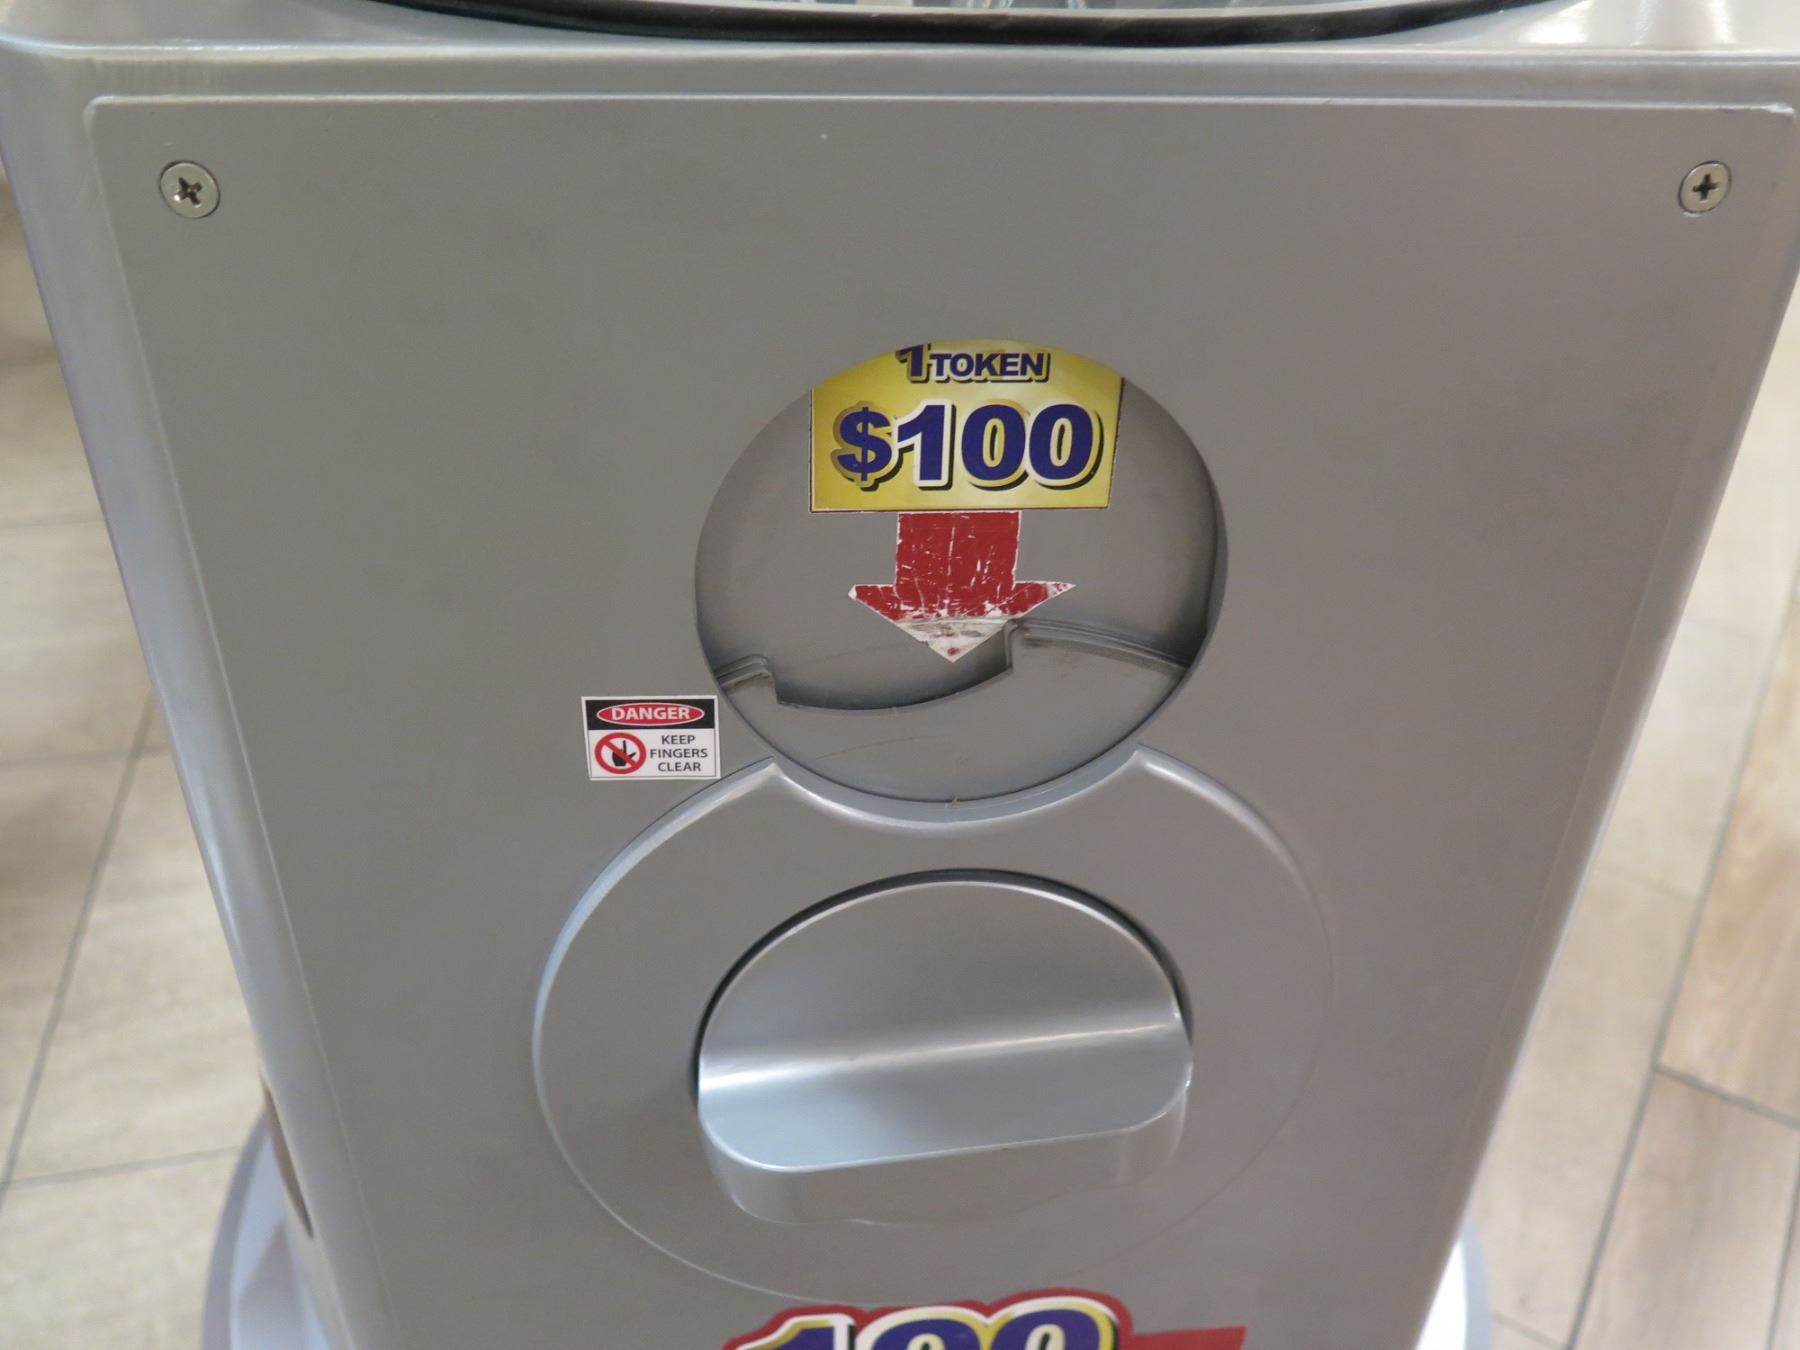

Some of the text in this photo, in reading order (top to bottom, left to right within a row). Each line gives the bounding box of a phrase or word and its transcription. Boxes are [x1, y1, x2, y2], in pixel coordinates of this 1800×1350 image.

[896, 344, 1048, 380] 1 TOKEN
[833, 401, 1099, 487] $100
[611, 706, 690, 721] DANGER
[661, 734, 696, 745] KEEP
[650, 748, 708, 758] FINGERS
[657, 761, 701, 772] CLEAR
